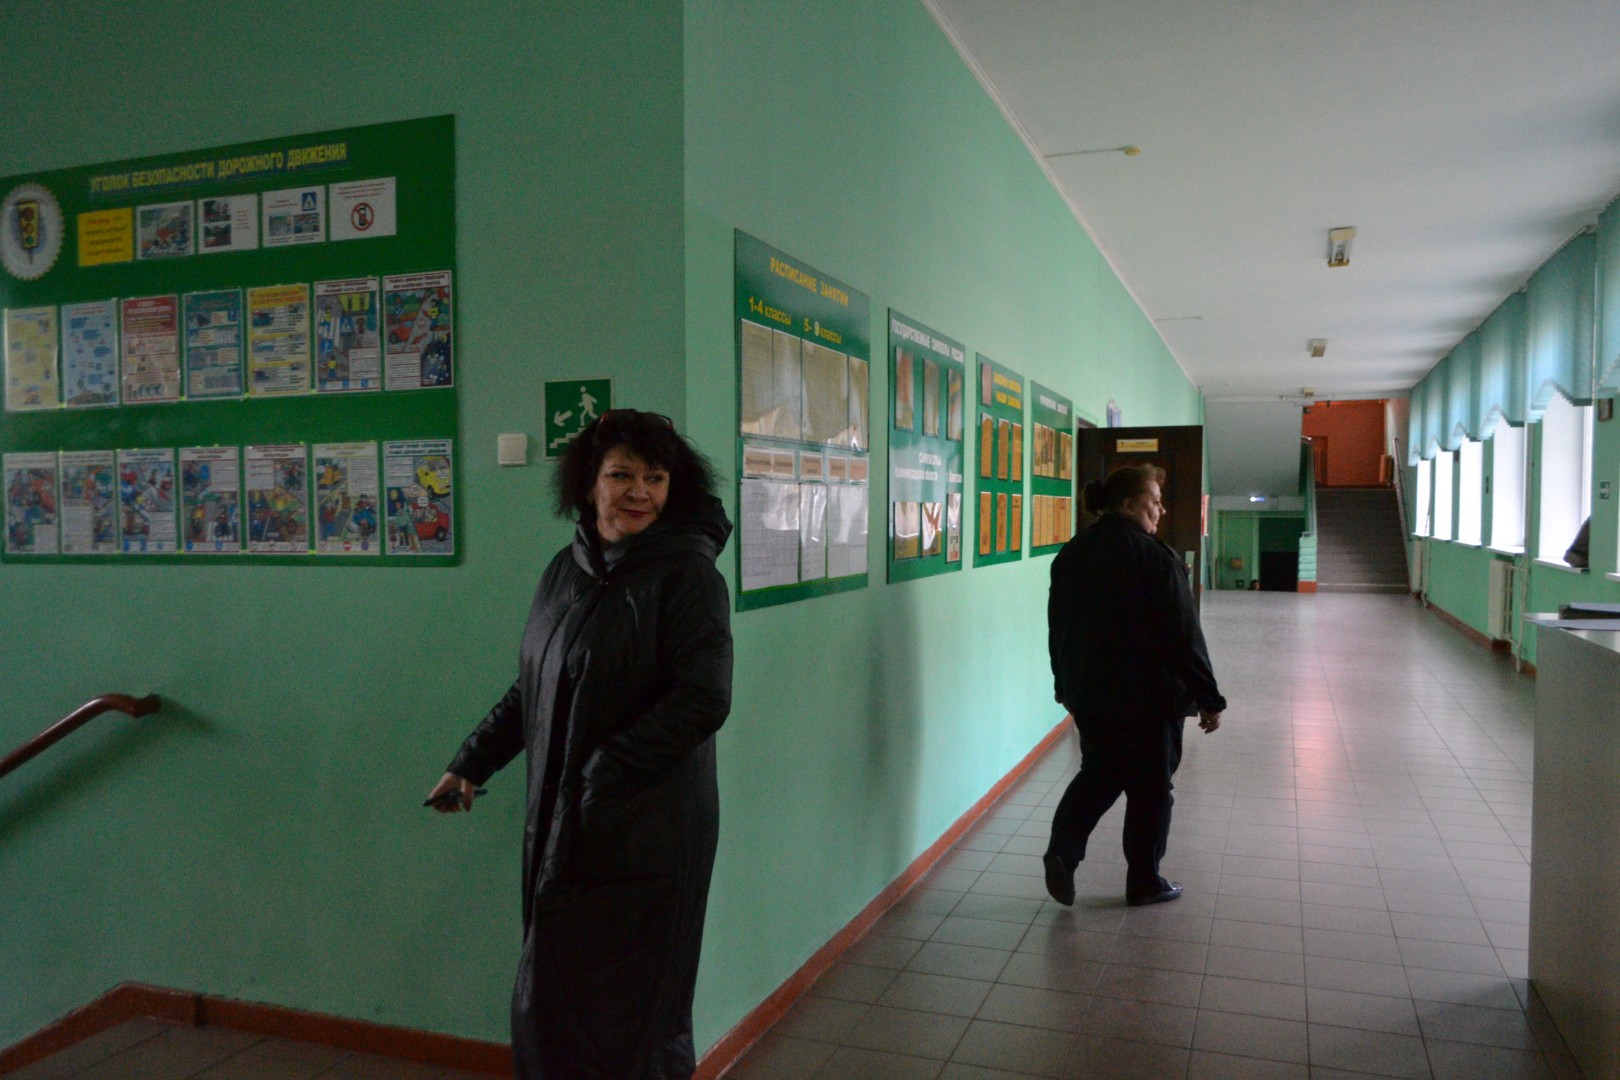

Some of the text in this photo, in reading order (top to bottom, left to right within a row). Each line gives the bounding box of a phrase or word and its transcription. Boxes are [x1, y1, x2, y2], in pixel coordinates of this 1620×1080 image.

[90, 142, 347, 193] УГОЛОК БЕЗОПАСНОСТИ ДОРОЖНОГО ДВИЖЕНИЯ
[770, 257, 817, 293] РАСПИСАНИЕ
[748, 296, 763, 315] 1-4
[764, 305, 791, 326] классы
[820, 328, 842, 345] классы
